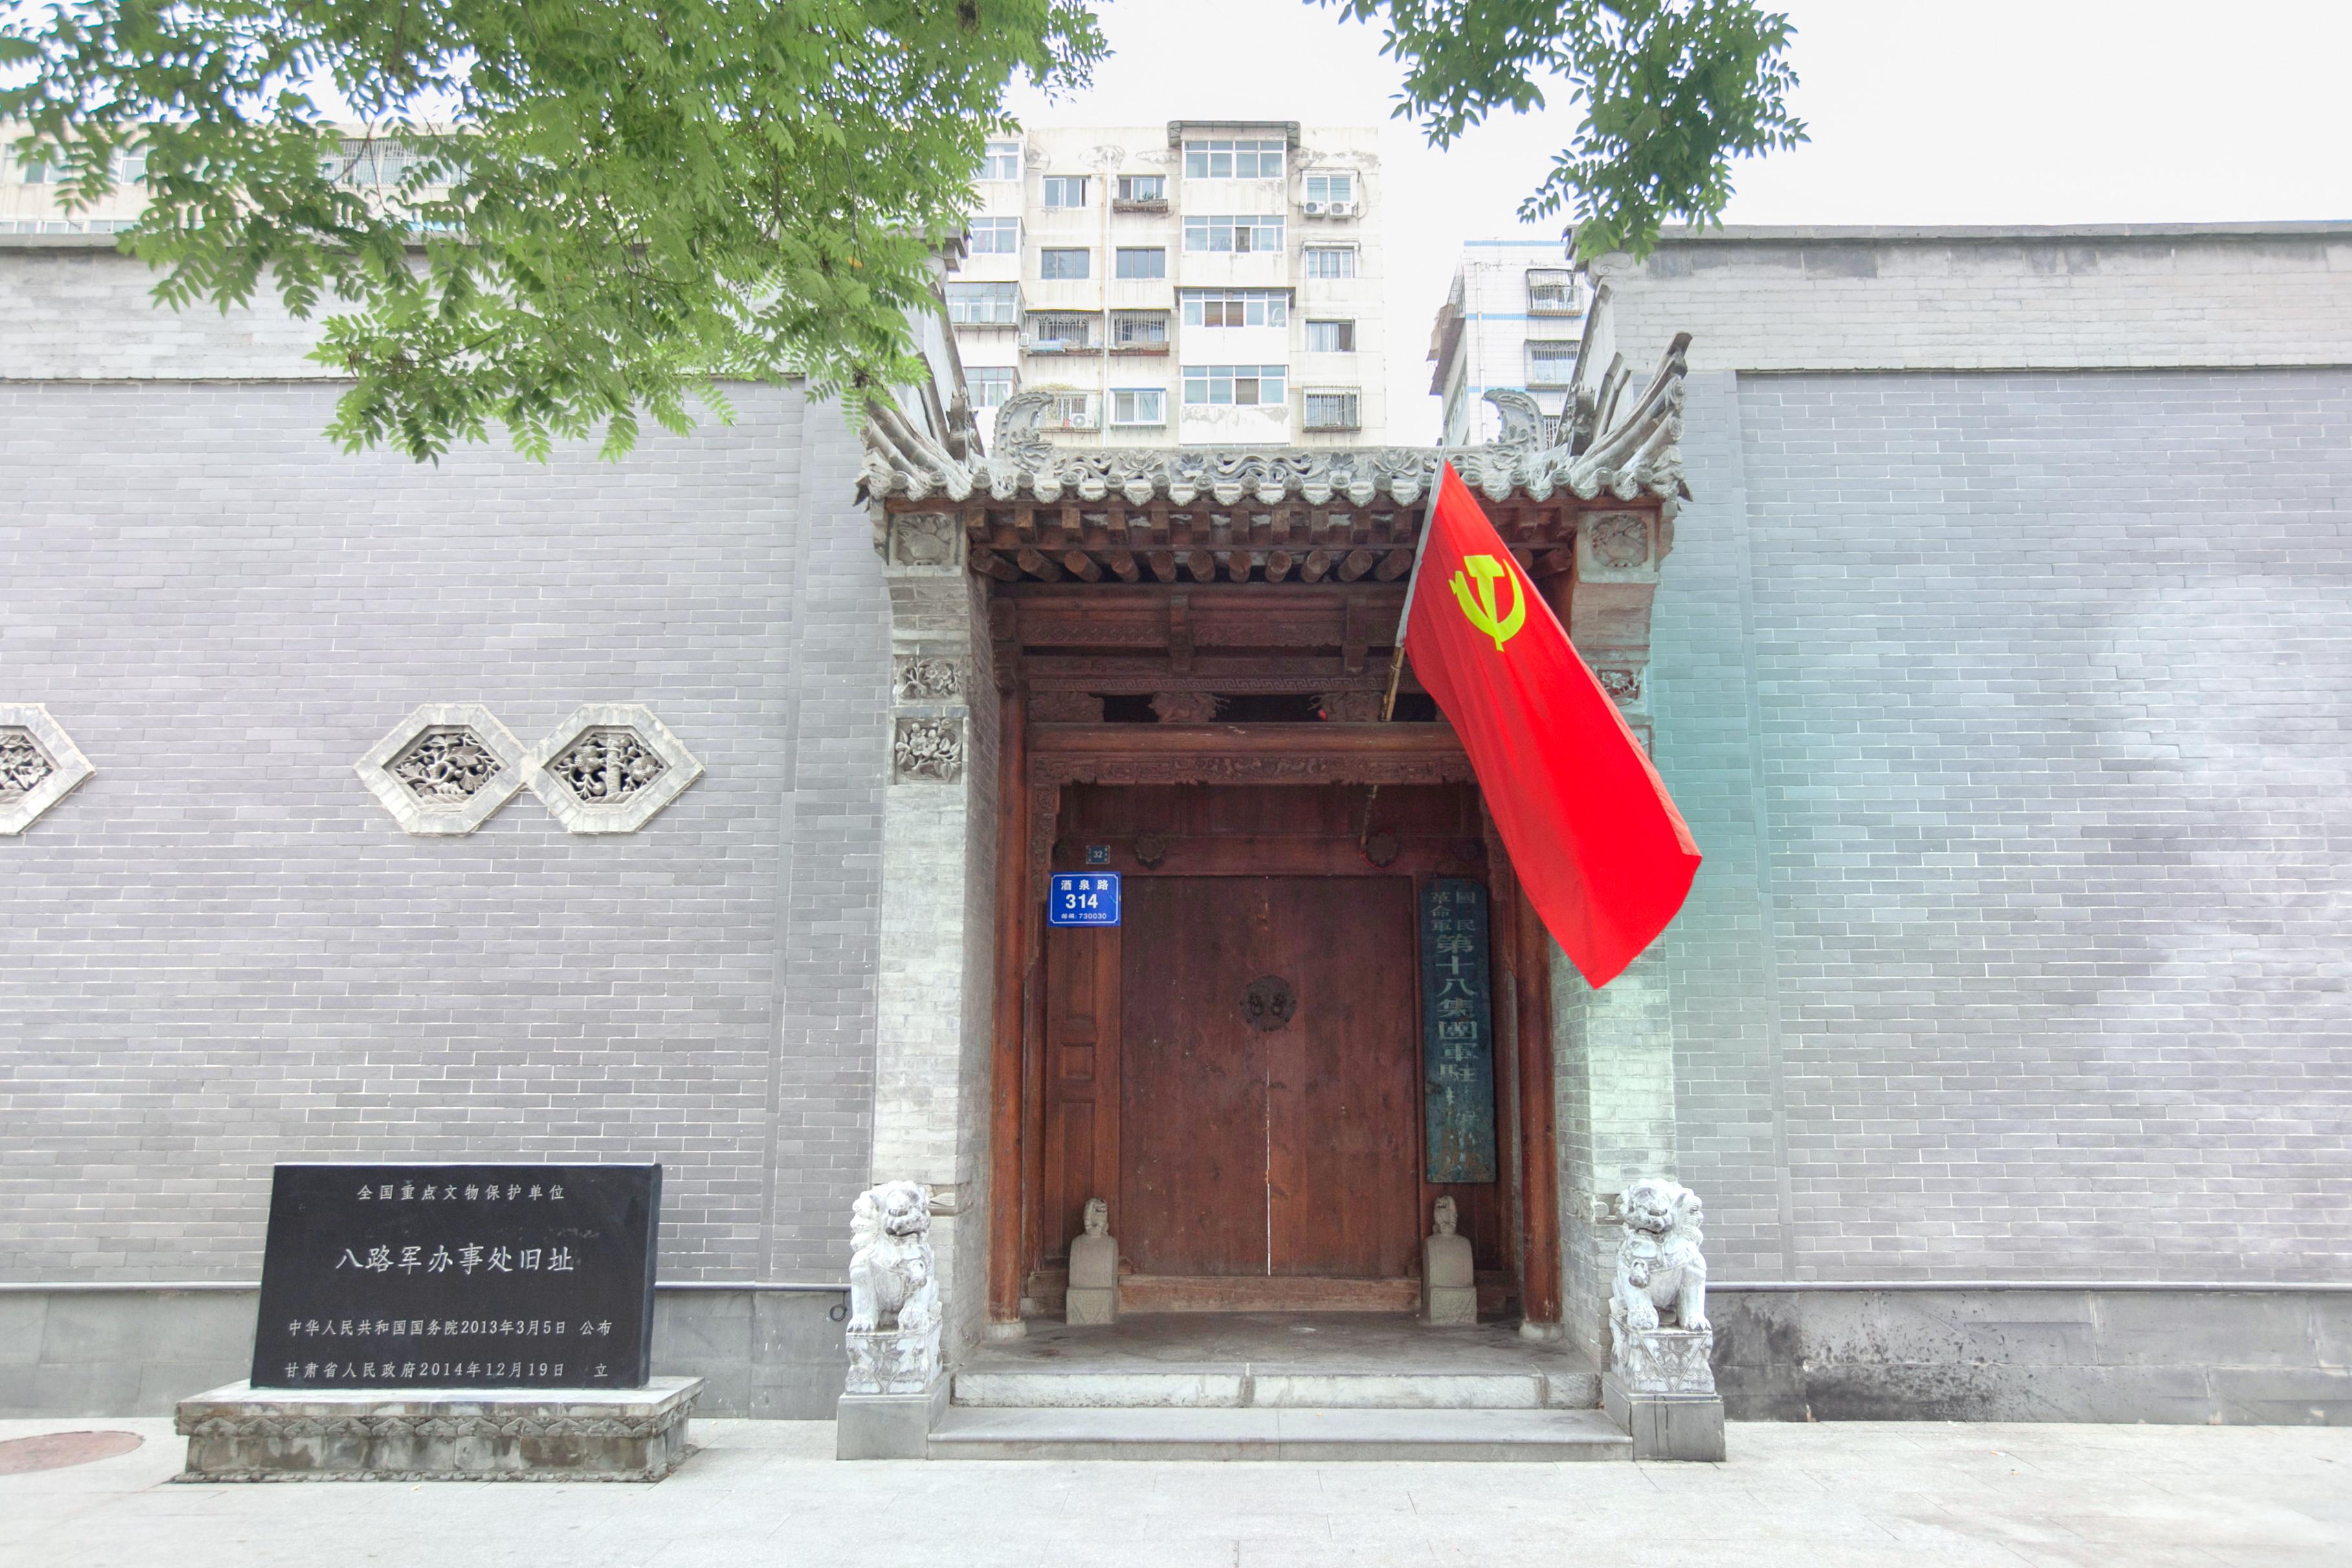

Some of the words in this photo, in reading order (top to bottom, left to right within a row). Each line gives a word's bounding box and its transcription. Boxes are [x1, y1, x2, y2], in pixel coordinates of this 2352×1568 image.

[1093, 850, 1103, 859] 32
[1061, 879, 1109, 890] 酒泉路
[1065, 894, 1098, 909] 314
[357, 1184, 564, 1200] 全国重点文物保护单位
[335, 1242, 574, 1275] 八路军办事处旧址
[289, 1319, 566, 1336] 中华人民共和国国务院2013年3月5日
[580, 1320, 612, 1336] 公布
[285, 1362, 564, 1378] 甘肃省人民政府2014年12月19日
[594, 1363, 608, 1378] 立
